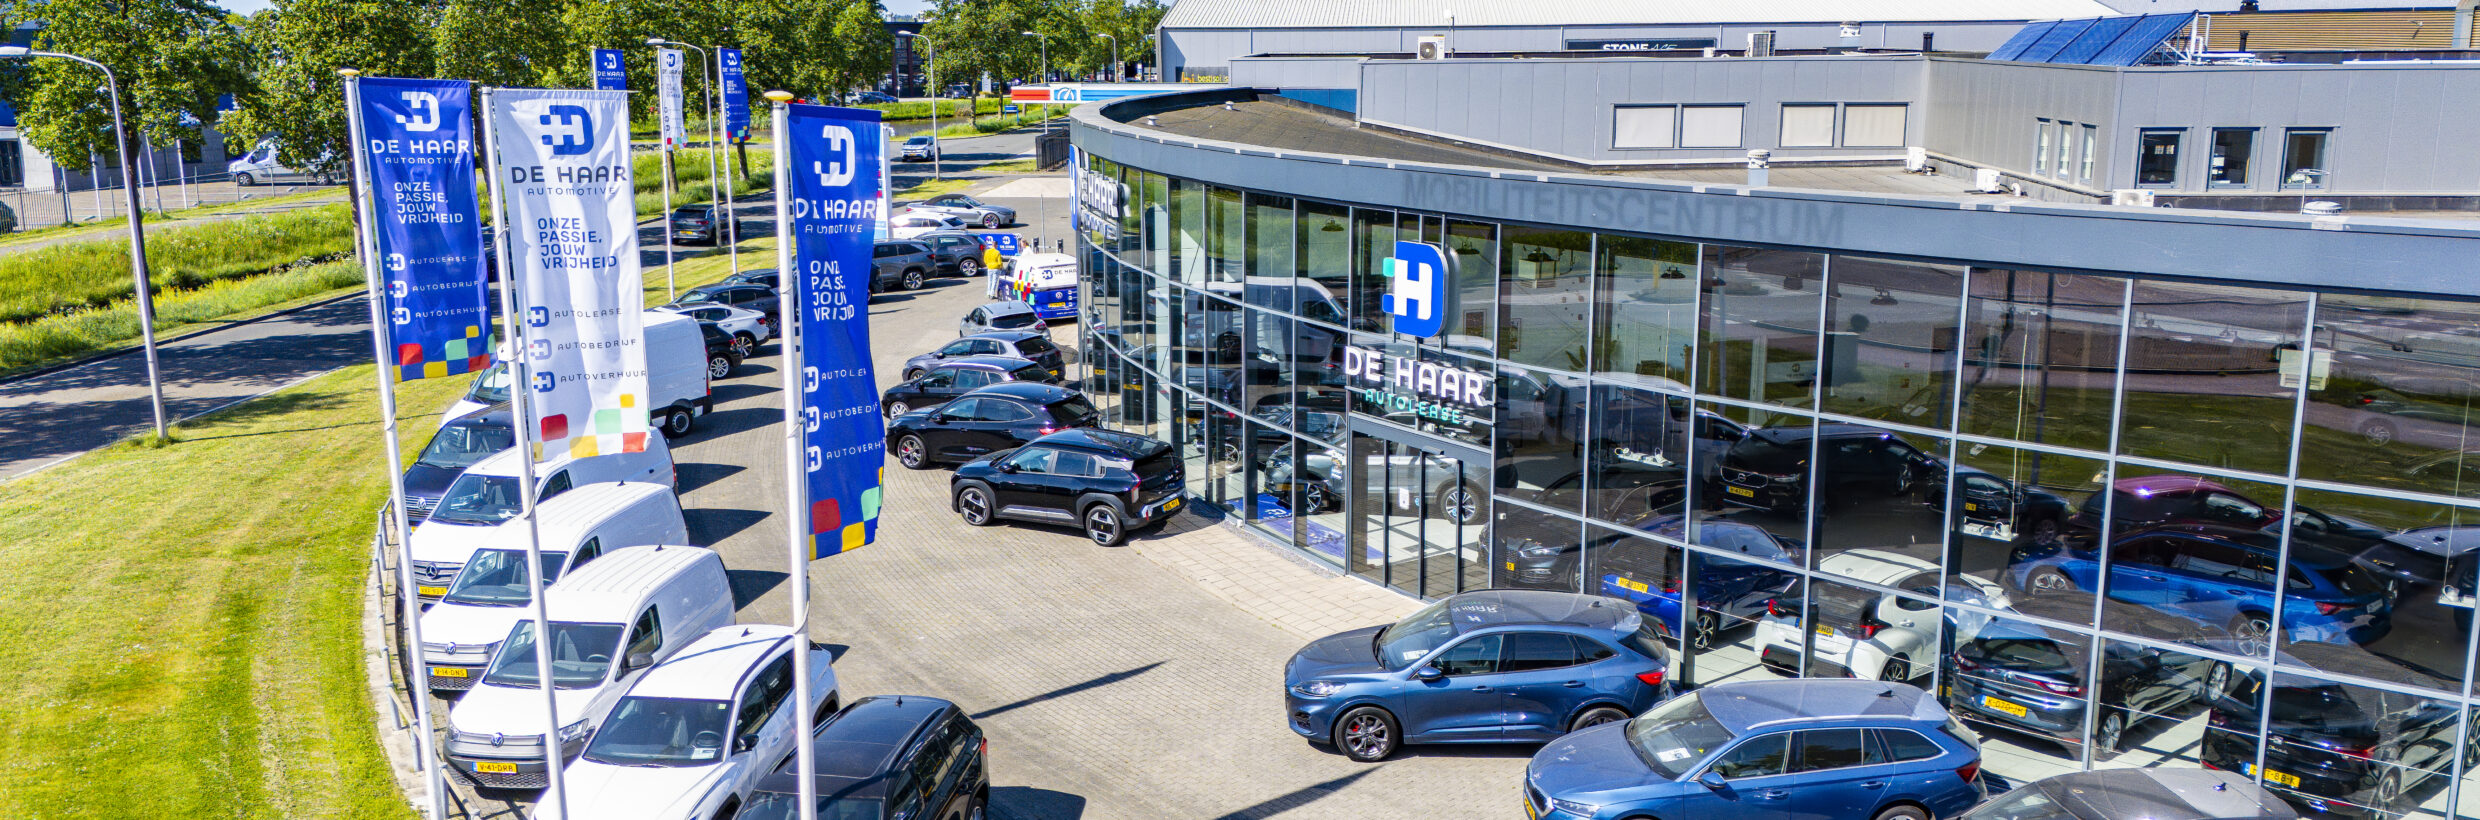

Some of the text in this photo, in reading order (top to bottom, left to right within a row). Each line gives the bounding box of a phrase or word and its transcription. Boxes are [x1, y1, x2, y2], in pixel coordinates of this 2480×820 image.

[371, 139, 470, 154] DE HAAR
[385, 157, 461, 165] AUTOMOTIVE
[511, 165, 628, 184] DE HAAR
[394, 181, 432, 192] ONZE
[527, 187, 616, 196] AUTOMOTIVE
[395, 192, 449, 203] PASSIE,
[396, 203, 436, 214] JOUW
[824, 199, 877, 220] HAAR
[1404, 172, 1845, 246] MOBILITEITSCENTRUM
[398, 213, 464, 224] VRIJHEID
[537, 217, 581, 230] ONZE
[539, 230, 602, 243] PASSIE,
[540, 243, 586, 257] JOUW
[409, 256, 467, 265] AUTOLEASE
[541, 255, 617, 270] VRIJHEID
[412, 281, 480, 292] AUTOBEDRIJF
[415, 305, 488, 318] AUTOVERHUUR
[554, 308, 622, 318] AUTOLEASE
[557, 338, 636, 351] AUTOBEDRIJF
[560, 370, 647, 383] AUTOVERHUUR
[1344, 345, 1485, 407] DE HAAR
[1365, 389, 1461, 424] AUTOLEASE
[435, 667, 465, 677] V-14-DNS
[479, 762, 514, 772] V-41-DRB
